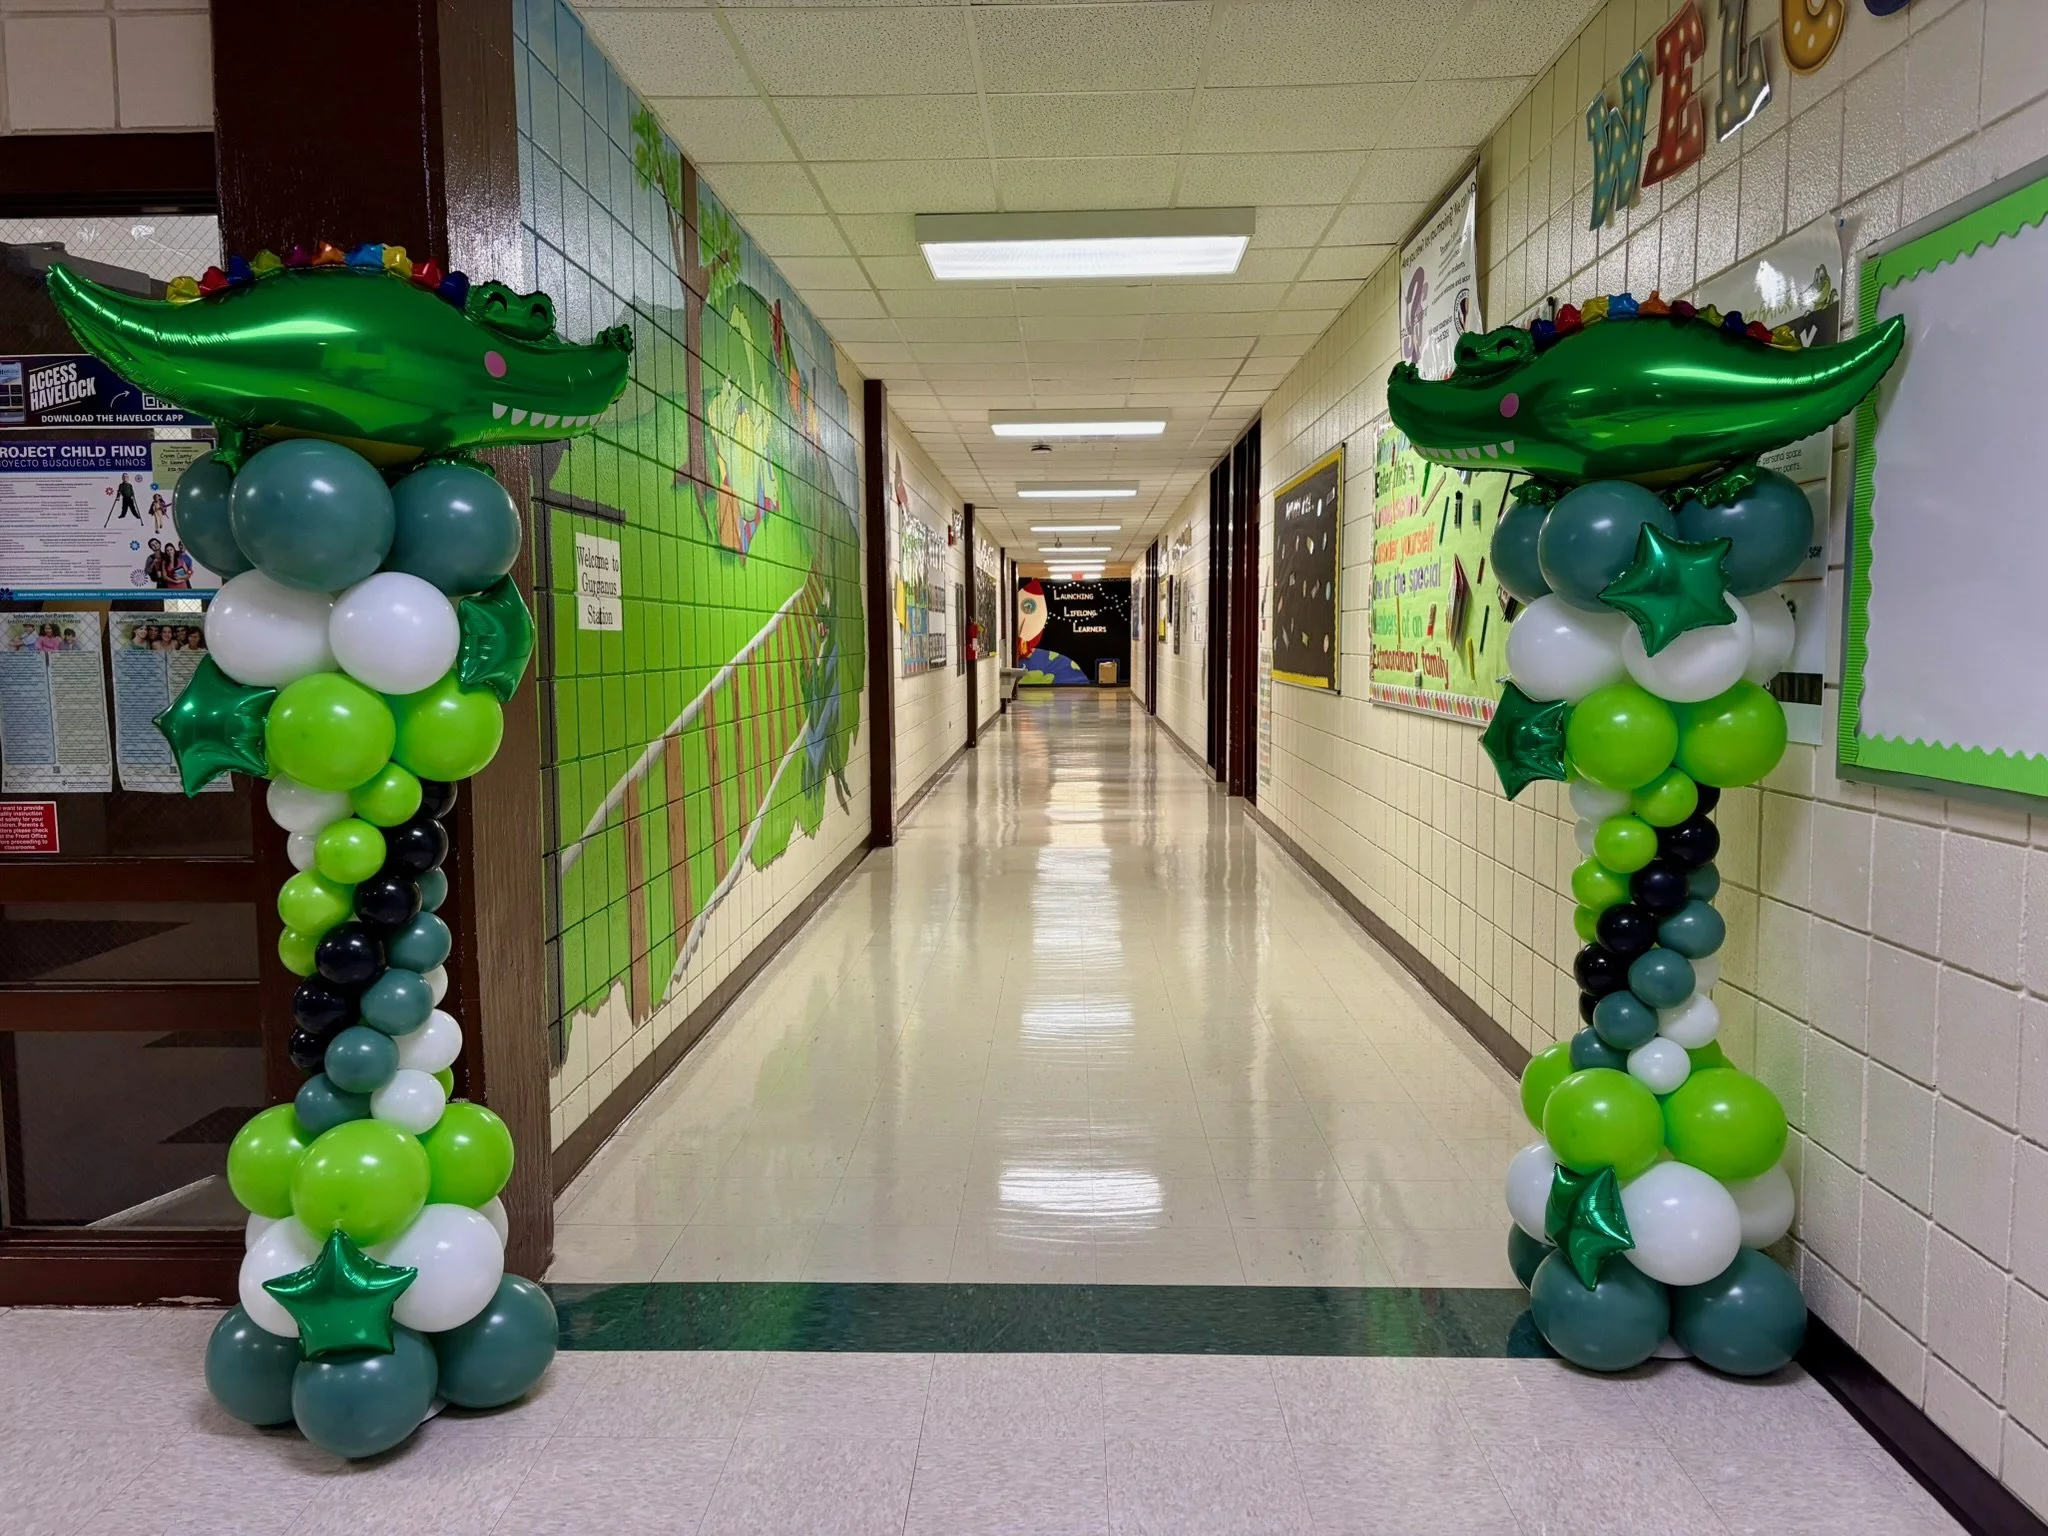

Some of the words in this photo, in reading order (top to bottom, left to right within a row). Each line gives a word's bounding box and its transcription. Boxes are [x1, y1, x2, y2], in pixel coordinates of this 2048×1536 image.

[29, 362, 78, 393] ACCESS
[30, 376, 96, 412] HAVELOCK
[42, 414, 94, 423] DOWNLOAD
[116, 414, 164, 422] HAVELOCK
[166, 414, 184, 422] APP
[0, 446, 56, 458] ROJECT
[60, 446, 107, 458] CHILD
[111, 445, 147, 457] FIND
[0, 458, 39, 468] OYECTO
[42, 456, 95, 468] BÚSQUEDA
[99, 458, 112, 467] DE
[114, 456, 146, 467] NIÑOS
[1400, 521, 1435, 566] yourself
[576, 546, 609, 571] Welcome
[612, 554, 619, 572] to
[582, 572, 617, 600] Gurganus
[1394, 566, 1406, 596] the
[1409, 556, 1442, 598] special
[588, 604, 614, 625] Station
[1402, 609, 1410, 638] of
[1412, 616, 1422, 638] an
[1421, 645, 1449, 690] family
